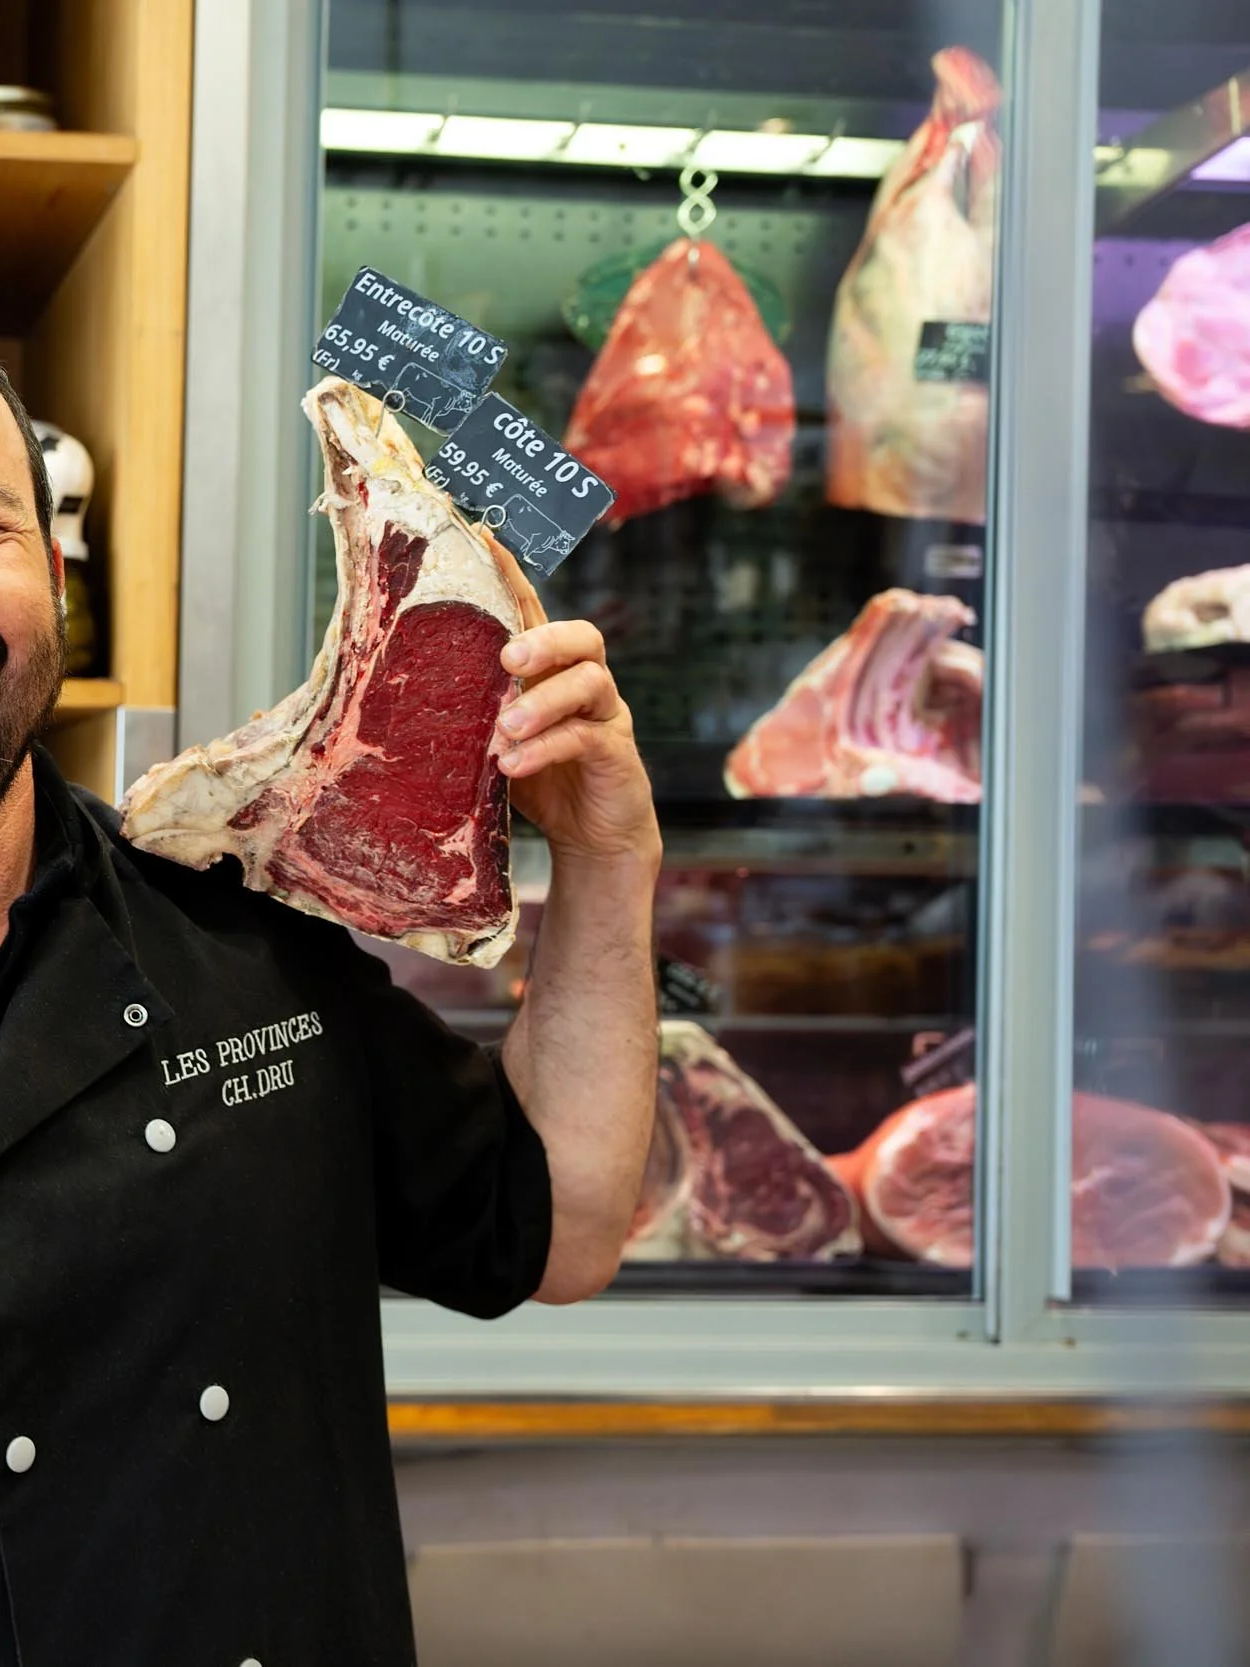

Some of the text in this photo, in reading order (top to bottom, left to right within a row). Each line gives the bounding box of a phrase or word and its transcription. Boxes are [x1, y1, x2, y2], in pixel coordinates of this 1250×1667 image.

[355, 273, 504, 365] Entrecôte 10 S
[377, 320, 439, 362] Maturée
[313, 349, 340, 371] (Fr)
[325, 324, 395, 371] 65,95 €
[425, 465, 450, 489] (Fr)
[438, 442, 504, 498] 59,95 €
[491, 447, 547, 498] Maturée
[493, 413, 599, 498] côte 10 S
[161, 1011, 323, 1086] LES PROVINCES
[222, 1060, 295, 1107] CH.DRU
